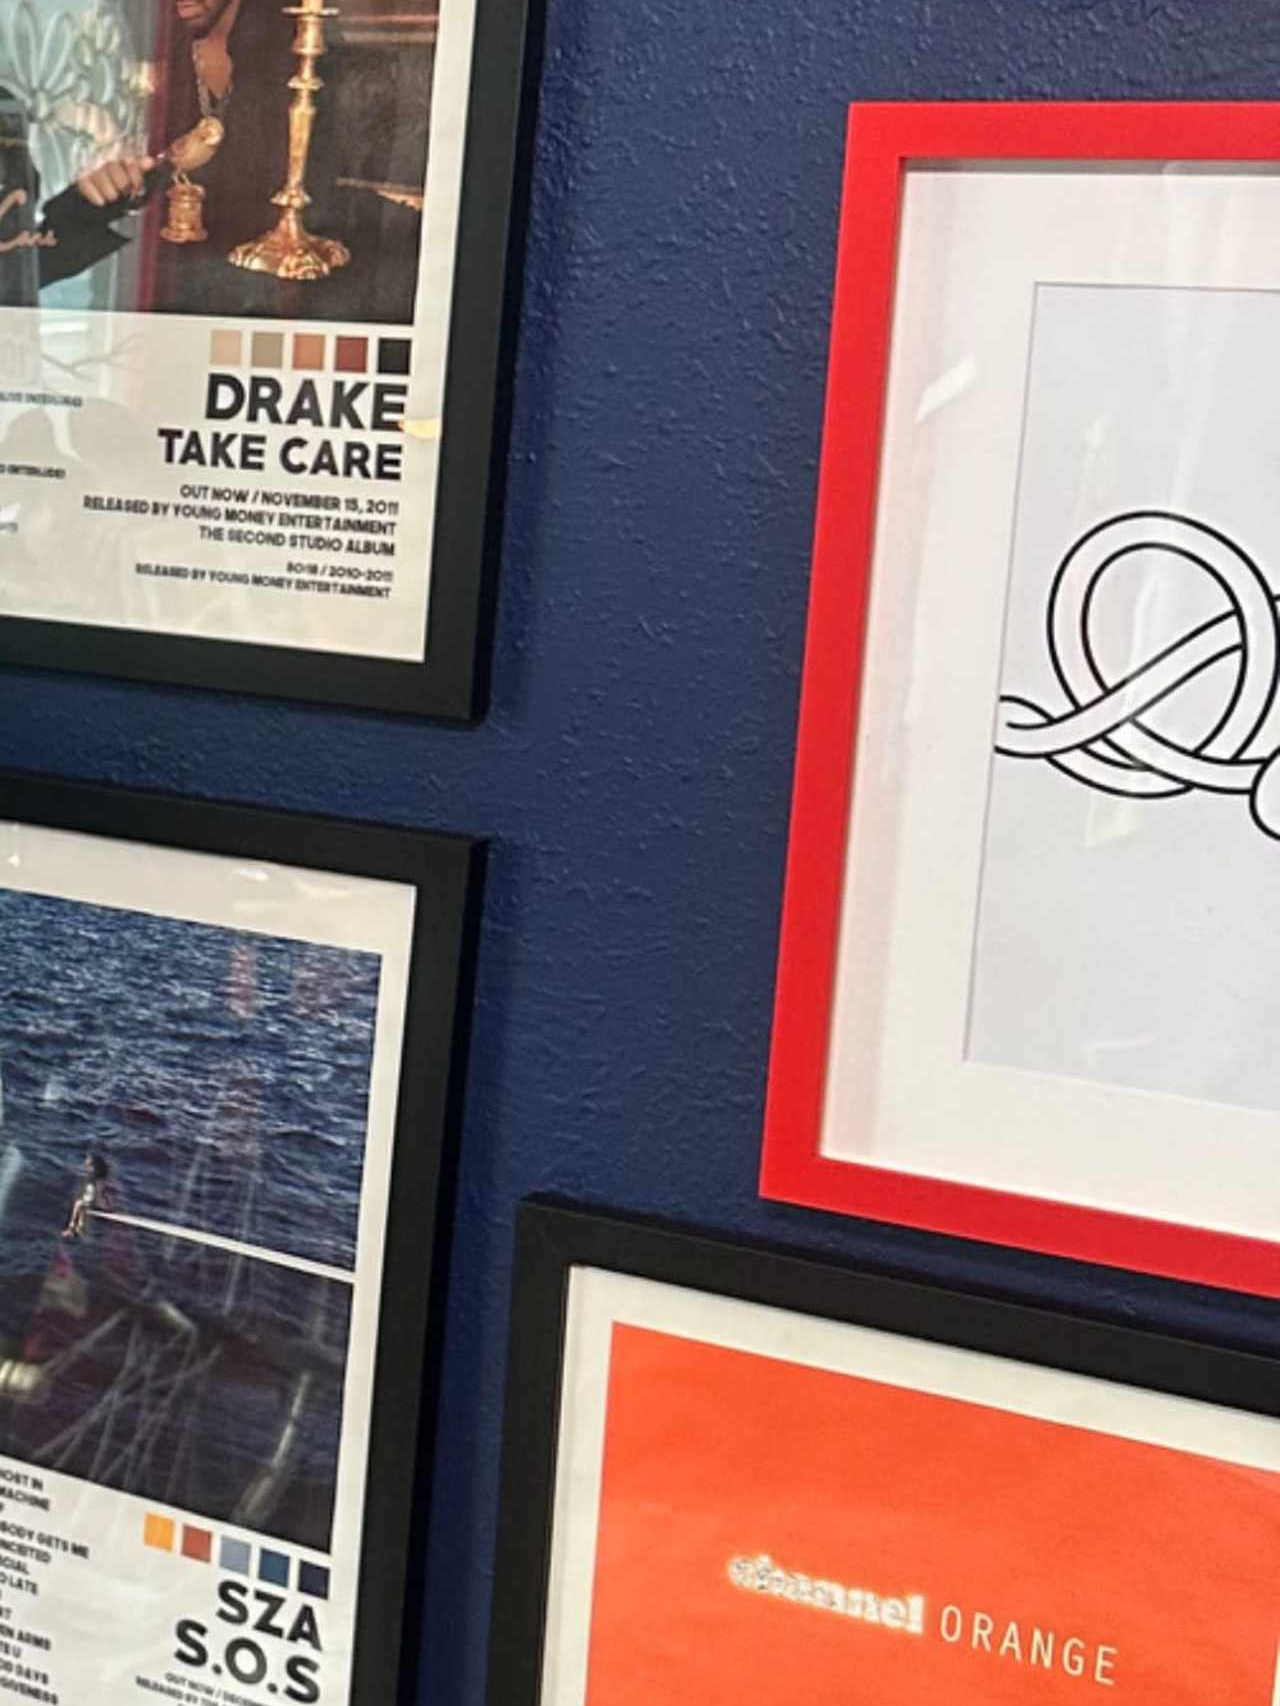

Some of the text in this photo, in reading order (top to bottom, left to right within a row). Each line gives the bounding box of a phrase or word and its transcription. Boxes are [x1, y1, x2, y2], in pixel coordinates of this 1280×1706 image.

[203, 371, 408, 433] DRAKE
[156, 427, 403, 481] TAKE CARE
[82, 494, 396, 535] RELEASED BY YOUNG MONEY ENTERTAINMENT
[178, 483, 209, 499] OUT
[210, 486, 249, 503] NOW
[260, 490, 341, 510] NOVEMBER
[198, 524, 395, 556] THE SECOND STUDIO ALBUM
[215, 1579, 322, 1652] SZA
[173, 1618, 320, 1704] S.O.S
[940, 1605, 1119, 1686] ORANGE
